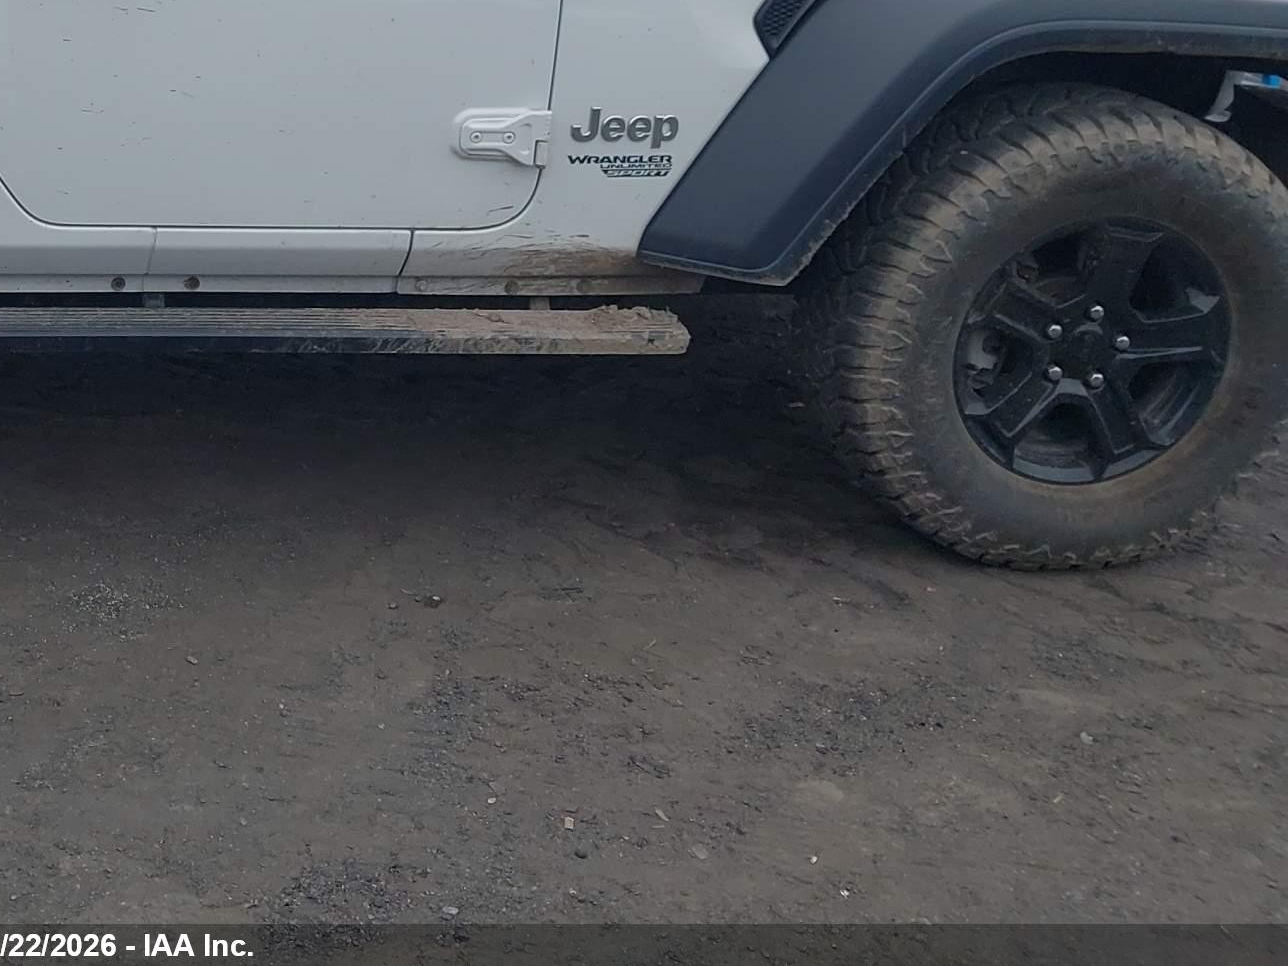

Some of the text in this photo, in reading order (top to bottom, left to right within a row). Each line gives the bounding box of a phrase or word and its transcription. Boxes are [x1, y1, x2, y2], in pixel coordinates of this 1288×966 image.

[570, 106, 679, 149] Jeep
[567, 154, 672, 164] WRANGLER
[599, 162, 672, 170] UNLIMITED
[606, 169, 670, 177] SPORT
